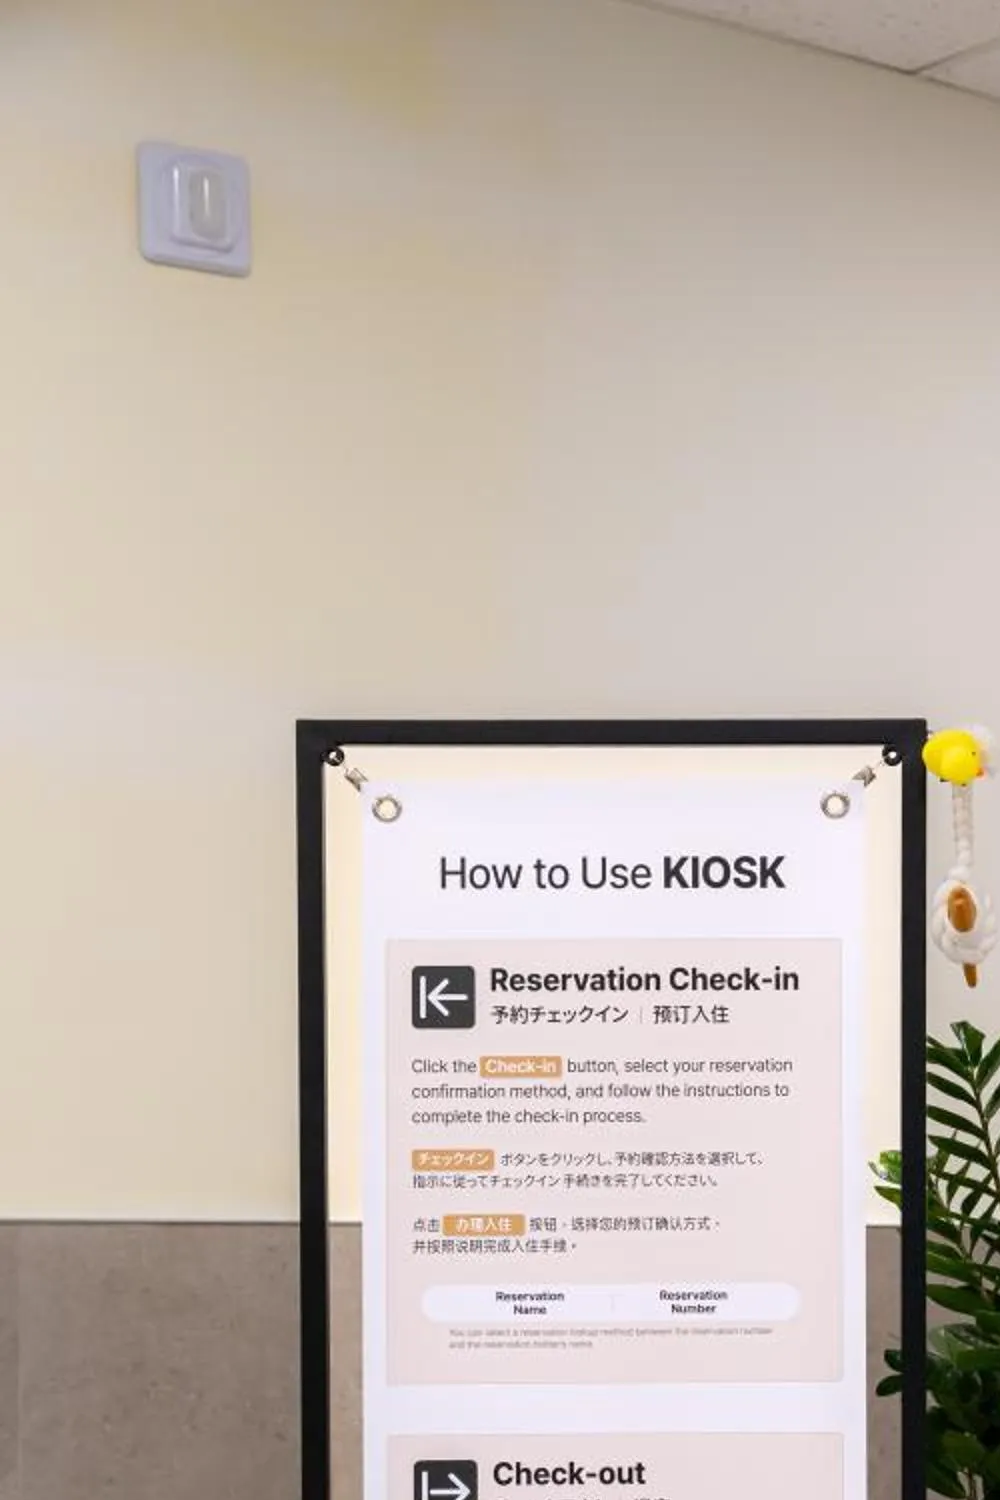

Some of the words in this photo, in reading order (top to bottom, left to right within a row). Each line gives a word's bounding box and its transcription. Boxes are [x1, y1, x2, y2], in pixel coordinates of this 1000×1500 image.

[440, 856, 522, 889] How
[534, 856, 569, 889] to
[581, 856, 652, 889] Use
[663, 856, 785, 889] KIOSK
[490, 968, 661, 991] Reservation
[670, 968, 799, 991] Check-in
[490, 1005, 629, 1025] 予約チェックイン
[653, 1005, 729, 1025] 预订入住
[412, 1059, 447, 1073] Click
[453, 1059, 476, 1073] the
[485, 1059, 557, 1074] Check-in
[568, 1059, 619, 1076] button,
[624, 1059, 668, 1073] select
[673, 1060, 705, 1077] your
[709, 1059, 792, 1073] reservation
[412, 1084, 505, 1098] confirmation
[509, 1084, 571, 1100] method,
[575, 1084, 603, 1097] and
[608, 1083, 651, 1097] follow
[656, 1083, 680, 1097] the
[684, 1083, 770, 1097] instructions
[774, 1084, 789, 1097] to
[412, 1109, 482, 1126] complete
[487, 1109, 510, 1123] the
[515, 1109, 579, 1123] check-in
[583, 1110, 646, 1126] process.
[417, 1152, 489, 1166] チェックイン
[412, 1218, 440, 1233] 点击
[495, 1291, 564, 1302] Reservation
[659, 1290, 728, 1301] Reservation
[513, 1304, 547, 1315] Name
[671, 1303, 716, 1314] Number
[493, 1462, 645, 1486] Check-out
